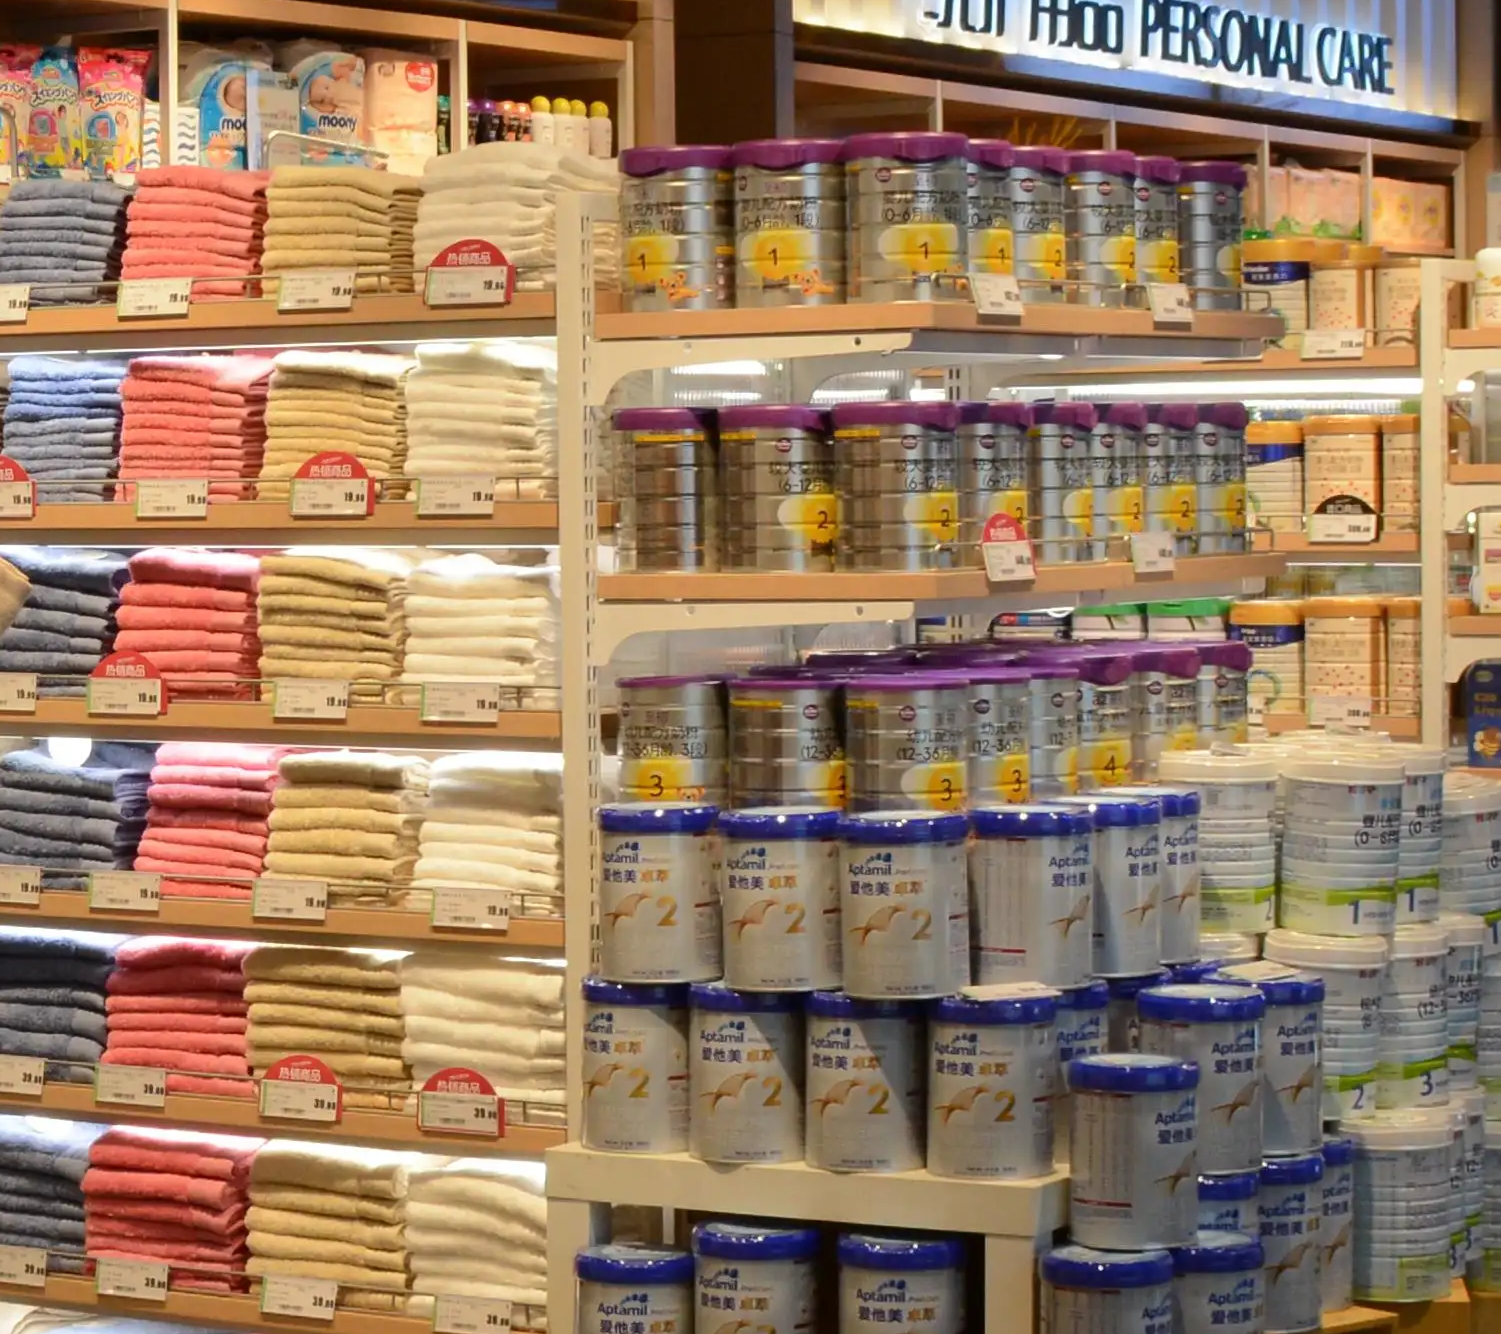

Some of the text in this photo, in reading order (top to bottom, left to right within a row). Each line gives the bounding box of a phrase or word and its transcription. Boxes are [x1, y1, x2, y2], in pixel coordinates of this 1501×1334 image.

[1317, 25, 1395, 95] CARE
[221, 116, 247, 131] moo
[318, 114, 358, 133] moony
[648, 774, 665, 798] 3
[848, 861, 893, 877] Aptamil
[656, 895, 679, 927] 2
[784, 902, 808, 934] 2
[911, 909, 934, 941] 2
[700, 1029, 746, 1045] Aptamil
[810, 1036, 851, 1051] Aptamil
[934, 1041, 979, 1057] Aptamil
[628, 1067, 650, 1099] 2
[761, 1075, 783, 1107] 2
[867, 1082, 890, 1115] 2
[994, 1089, 1016, 1122] 2
[856, 1287, 907, 1304] Aptamil
[597, 1301, 648, 1317] Aptamil
